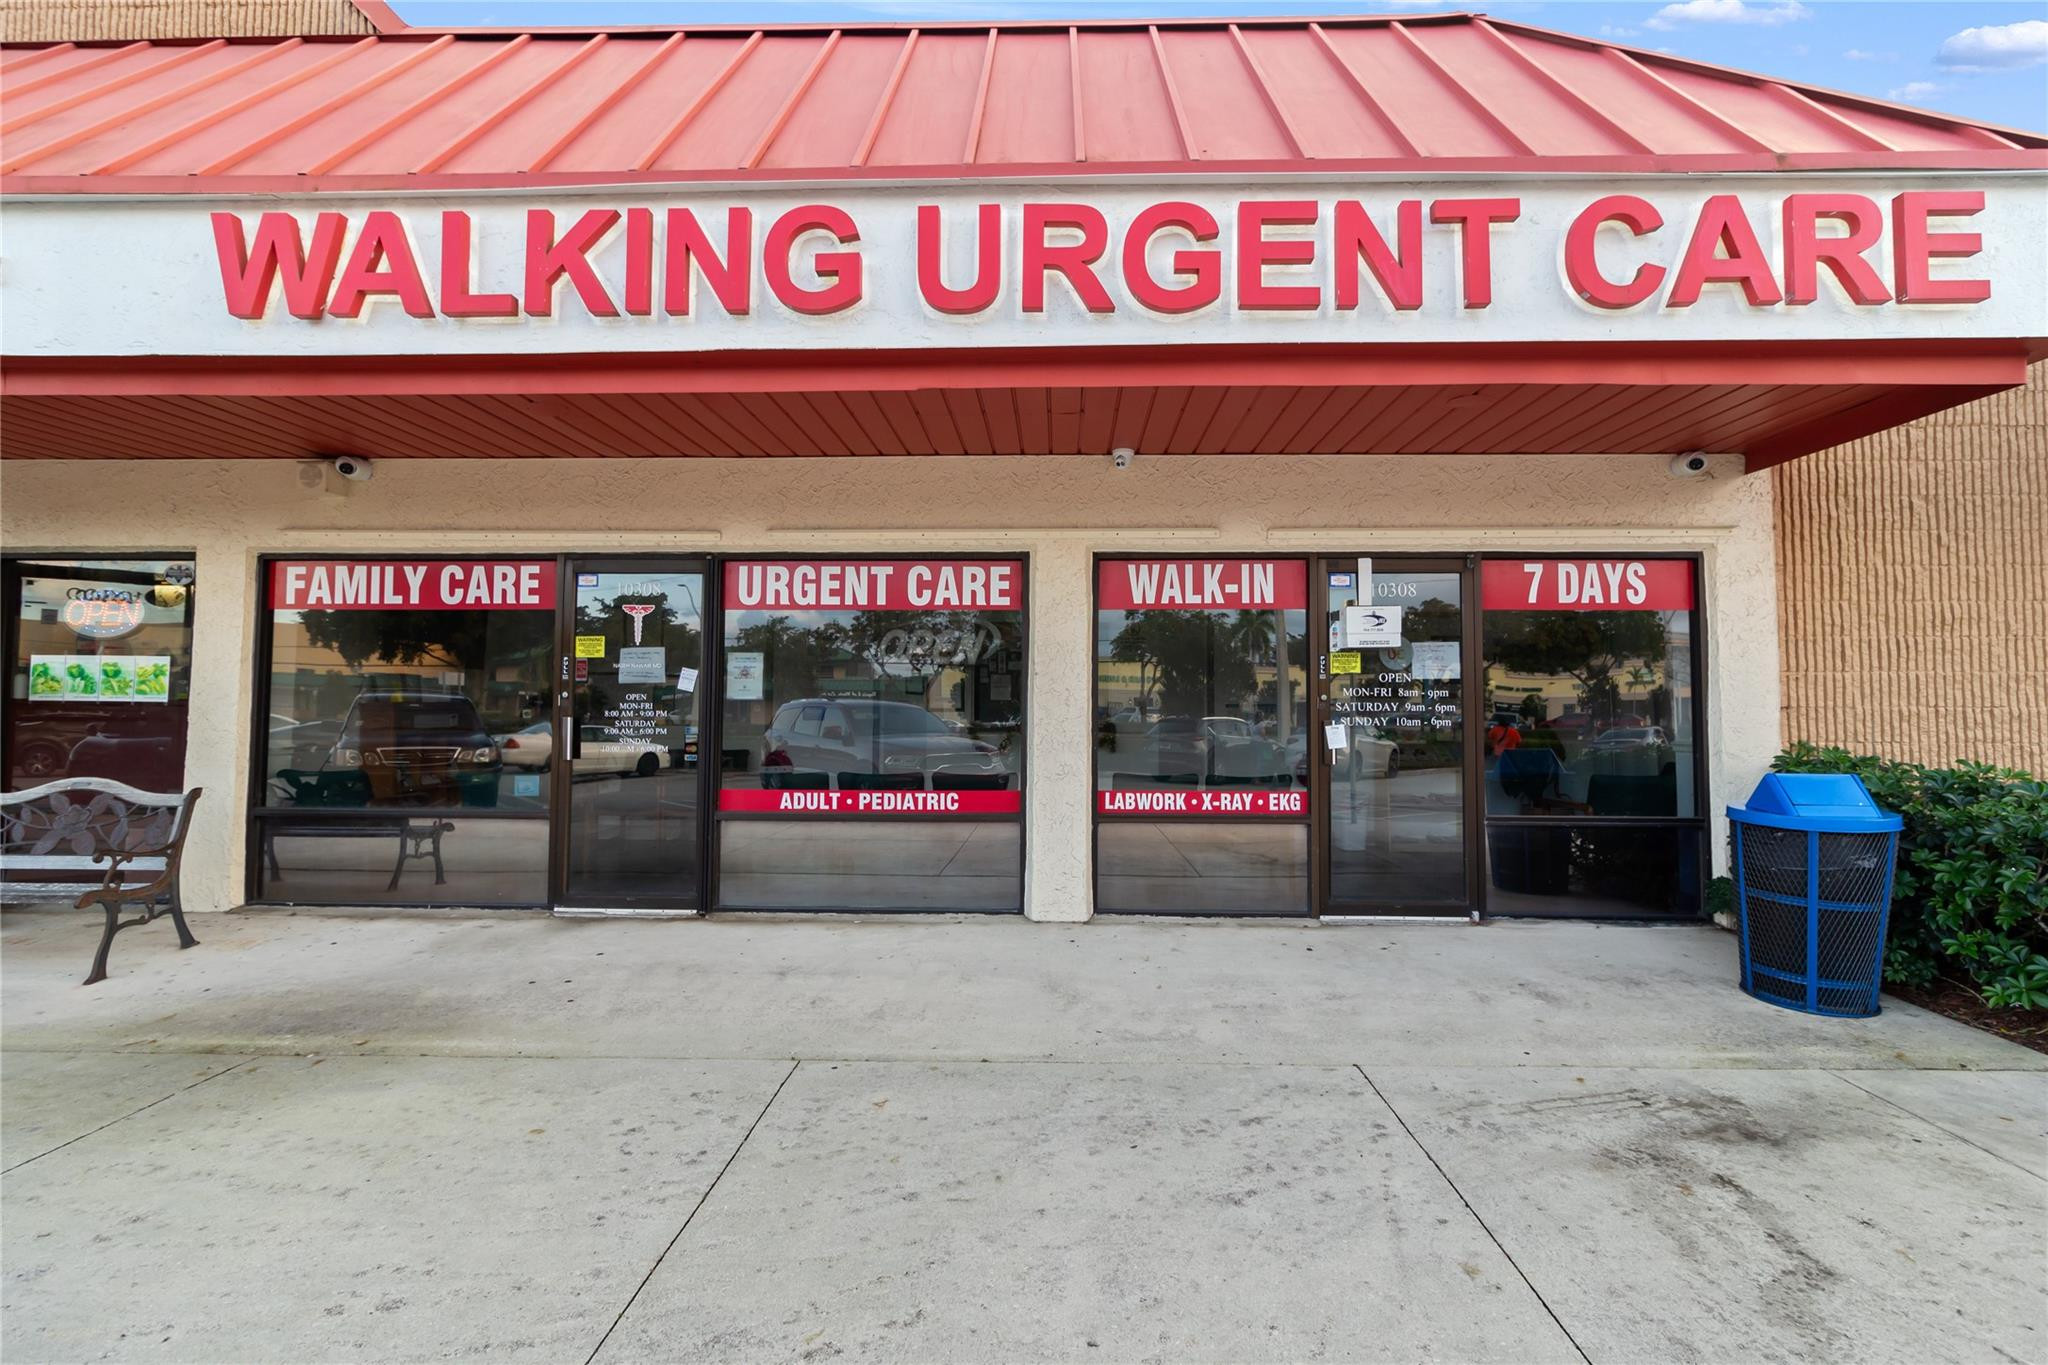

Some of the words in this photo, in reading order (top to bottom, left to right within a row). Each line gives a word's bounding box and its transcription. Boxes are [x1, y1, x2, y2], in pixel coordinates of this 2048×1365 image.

[210, 204, 863, 320] WALKING
[916, 200, 1520, 315] URGENT
[1566, 191, 1991, 309] CARE
[285, 565, 427, 605] FAMILY
[439, 565, 541, 605] CARE
[617, 582, 662, 597] 10308
[737, 565, 893, 606] URGENT
[907, 565, 1012, 606] CARE
[1127, 563, 1275, 604] WALK-IN
[1523, 563, 1544, 604] 7
[1557, 563, 1647, 604] DAYS
[66, 600, 141, 626] OPEN
[1378, 672, 1412, 683] OPEN
[625, 693, 647, 701] OPEN
[1343, 687, 1392, 697] MON-FRI
[1398, 687, 1418, 697] 8am
[1427, 688, 1449, 700] 9pm
[619, 702, 653, 710] MON-FRI
[1335, 702, 1398, 712] SATURDAY
[1405, 702, 1426, 712] 9am
[1435, 703, 1456, 714] 6pm
[604, 710, 619, 718] 8:00
[620, 710, 634, 718] AM
[639, 710, 654, 718] 9:00
[655, 710, 668, 718] PM
[1340, 716, 1389, 727] SUNDAY
[1396, 717, 1421, 727] 10am
[1430, 716, 1452, 729] 6pm
[618, 737, 652, 745] SUNDAY
[780, 793, 840, 811] ADULT
[859, 793, 959, 811] PEDIATRIC
[1104, 792, 1187, 811] LABWORK
[1202, 793, 1253, 811] X-RAY
[1269, 793, 1301, 811] EKG
